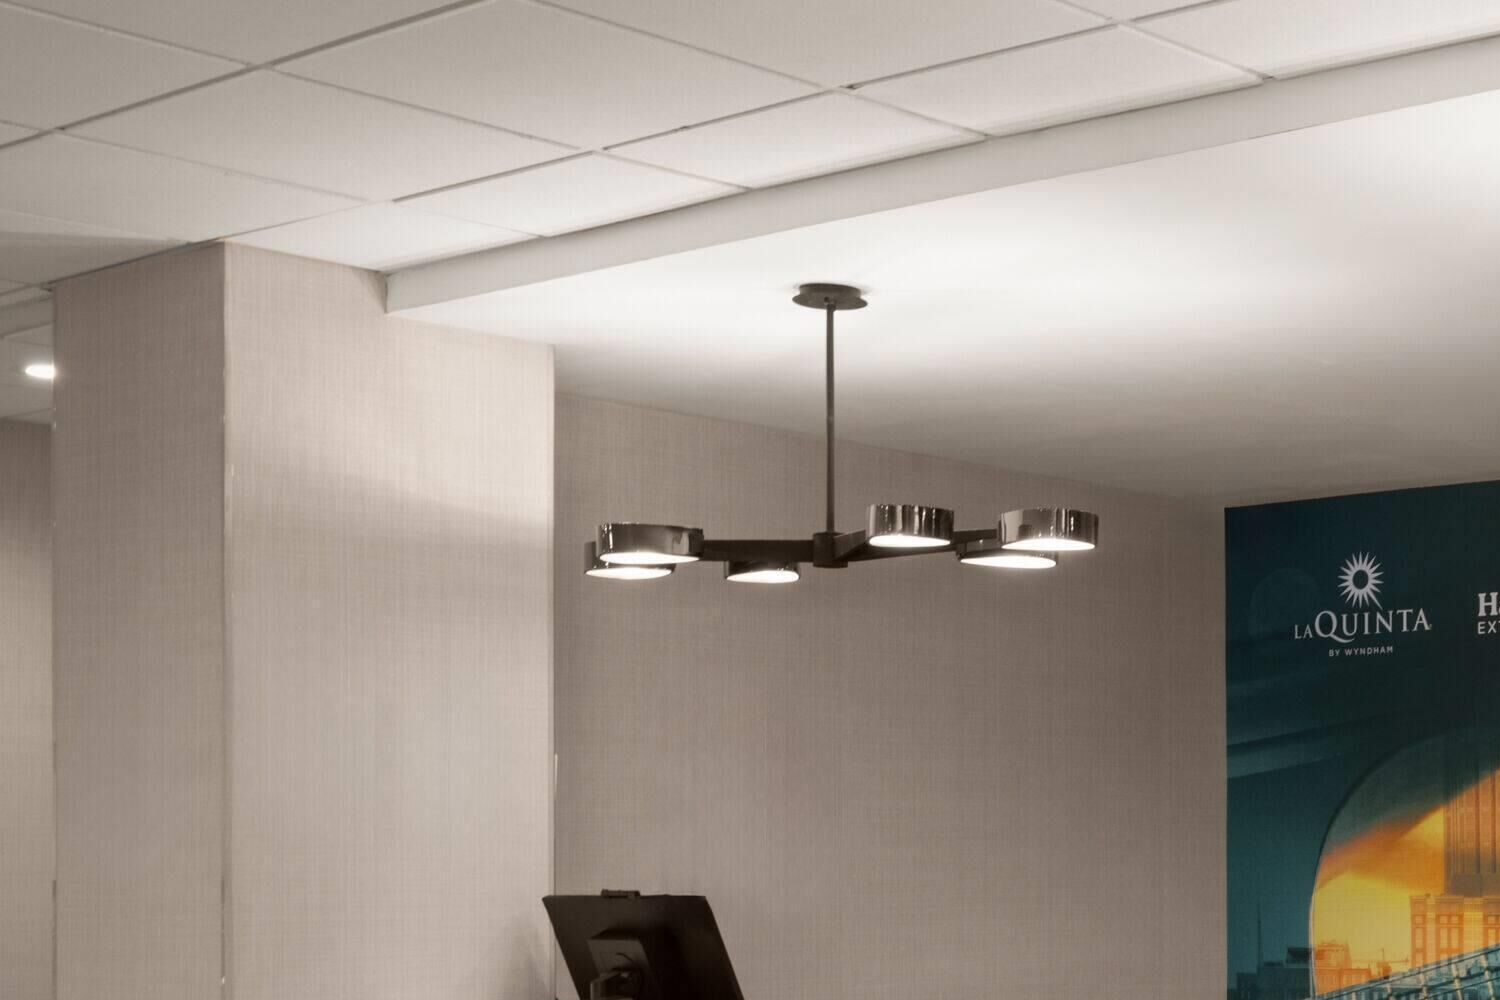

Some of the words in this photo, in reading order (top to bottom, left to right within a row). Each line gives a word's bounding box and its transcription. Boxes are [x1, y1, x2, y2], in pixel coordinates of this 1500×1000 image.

[1294, 624, 1313, 639] LA
[1314, 608, 1431, 643] QUINTA
[1328, 649, 1341, 657] BY
[1344, 646, 1393, 656] WYNDHAM
